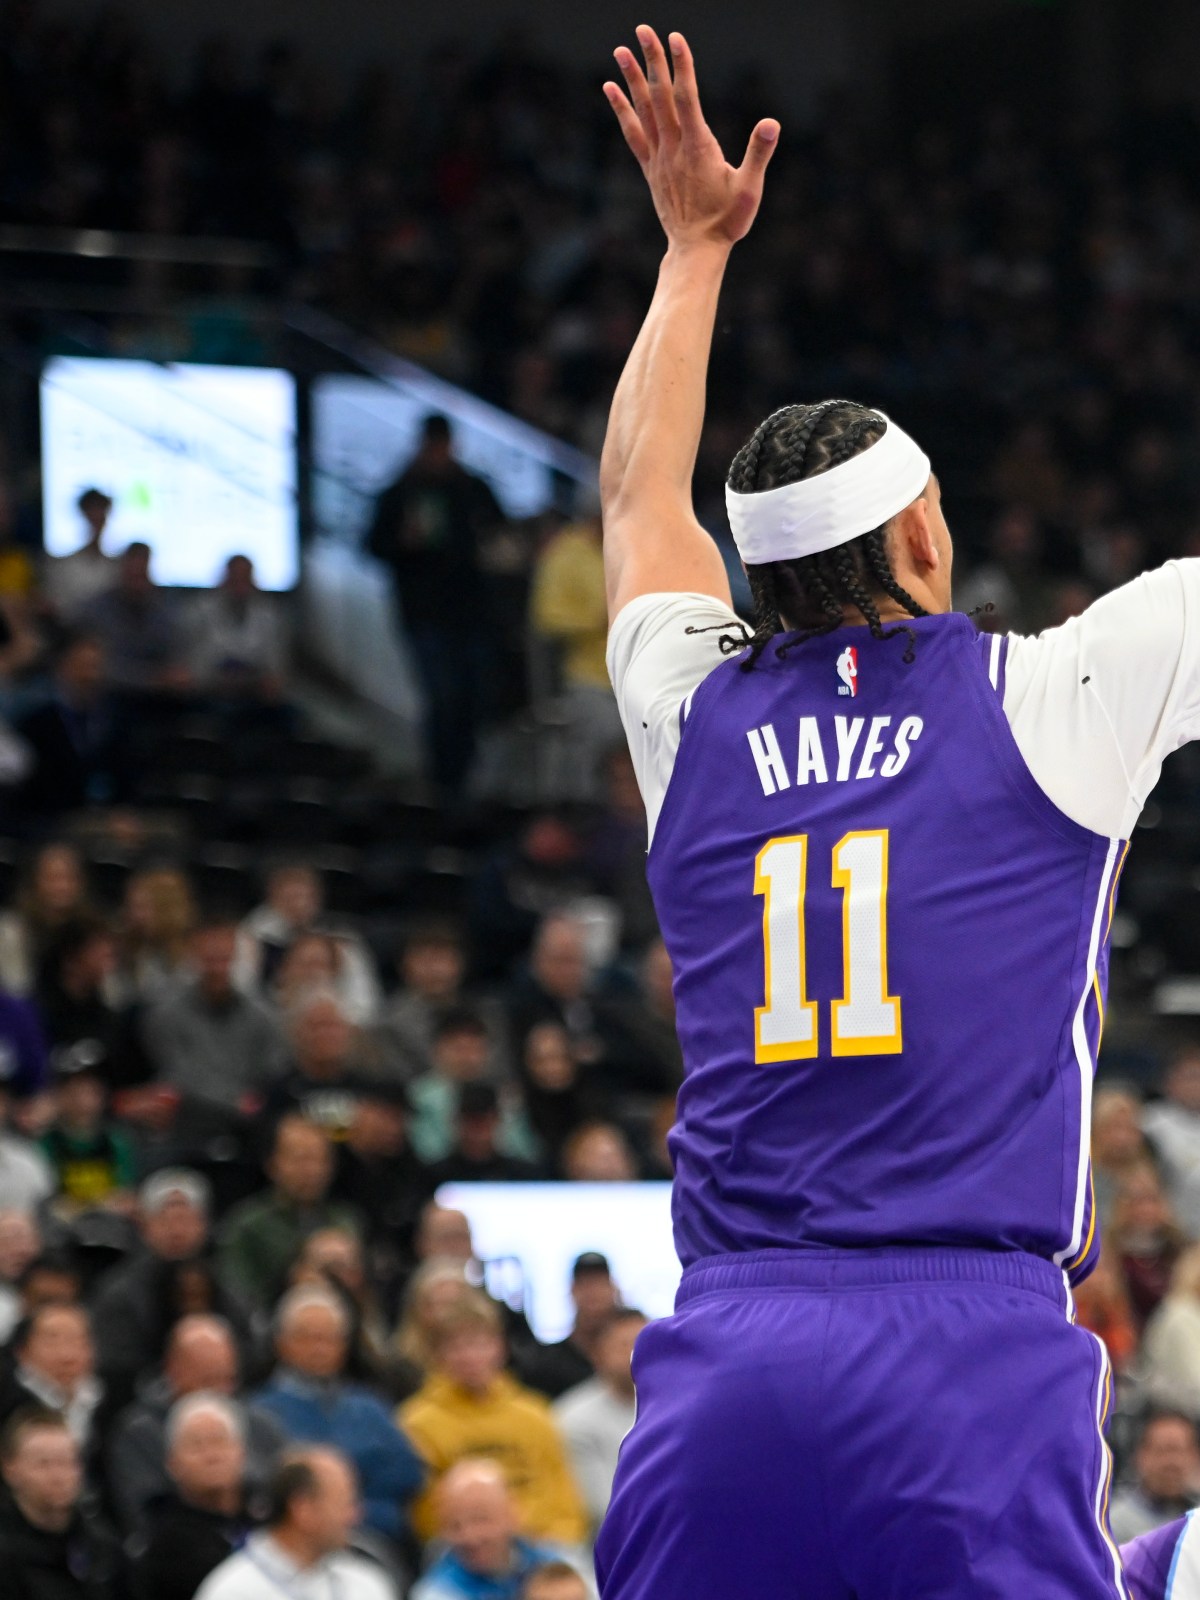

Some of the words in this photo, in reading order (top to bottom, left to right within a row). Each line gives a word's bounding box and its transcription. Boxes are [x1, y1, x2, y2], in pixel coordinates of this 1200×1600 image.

[837, 685, 850, 696] NBA
[746, 714, 924, 796] HAYES
[753, 829, 902, 1065] 11
